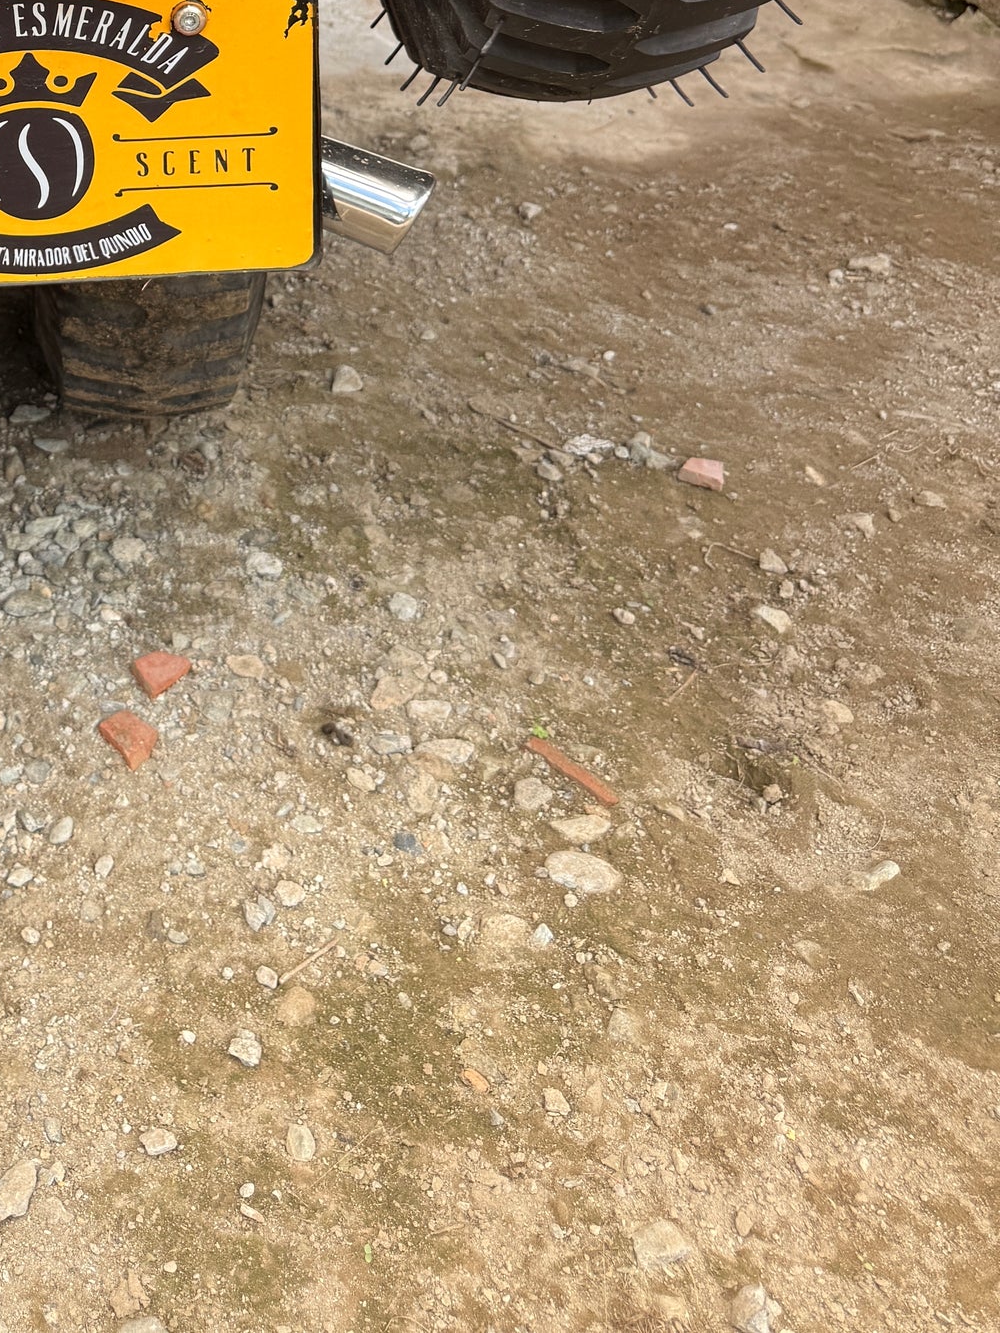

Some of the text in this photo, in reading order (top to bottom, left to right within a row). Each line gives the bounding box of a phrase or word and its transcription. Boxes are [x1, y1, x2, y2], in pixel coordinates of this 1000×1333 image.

[12, 2, 189, 74] ESMERALDA
[135, 147, 256, 177] SCENT
[12, 247, 72, 267] MIRADOR
[72, 241, 100, 263] DEL
[98, 222, 152, 259] QUINDIO
